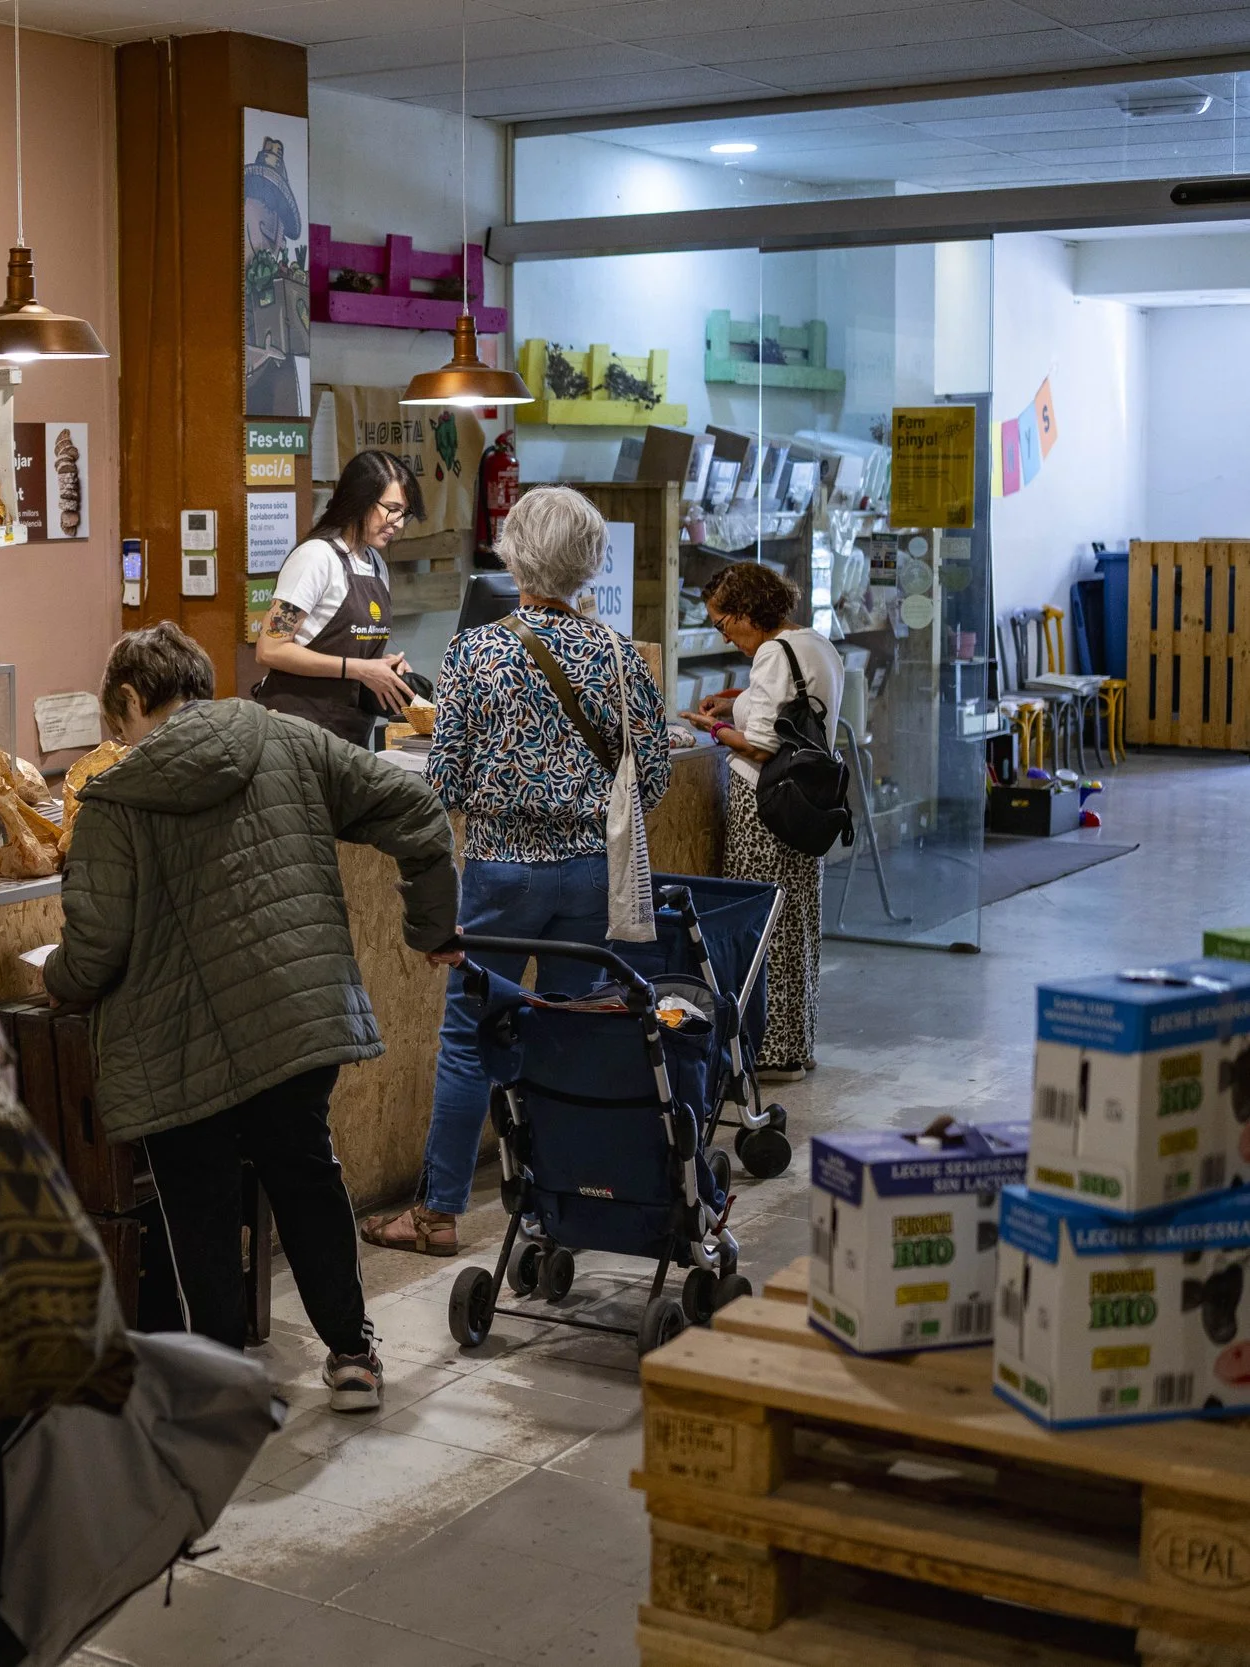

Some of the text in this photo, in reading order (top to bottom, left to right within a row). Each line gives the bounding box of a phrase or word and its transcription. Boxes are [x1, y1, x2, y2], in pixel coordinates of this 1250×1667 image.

[249, 430, 305, 449] Fes-te'n
[13, 453, 33, 471] jar
[249, 457, 292, 478] soci/a
[249, 501, 272, 511] Persona
[250, 537, 272, 547] Persona
[250, 548, 286, 558] consumidora
[251, 588, 273, 603] 20%
[350, 624, 368, 634] Som
[891, 1156, 1027, 1180] LECHE SEMIDESN
[932, 1176, 962, 1194] SIN
[1142, 1218, 1250, 1245] SEMIDESNA
[892, 1234, 956, 1271] BIO
[1088, 1293, 1159, 1331] BIO
[1167, 1535, 1245, 1581] EPAL
